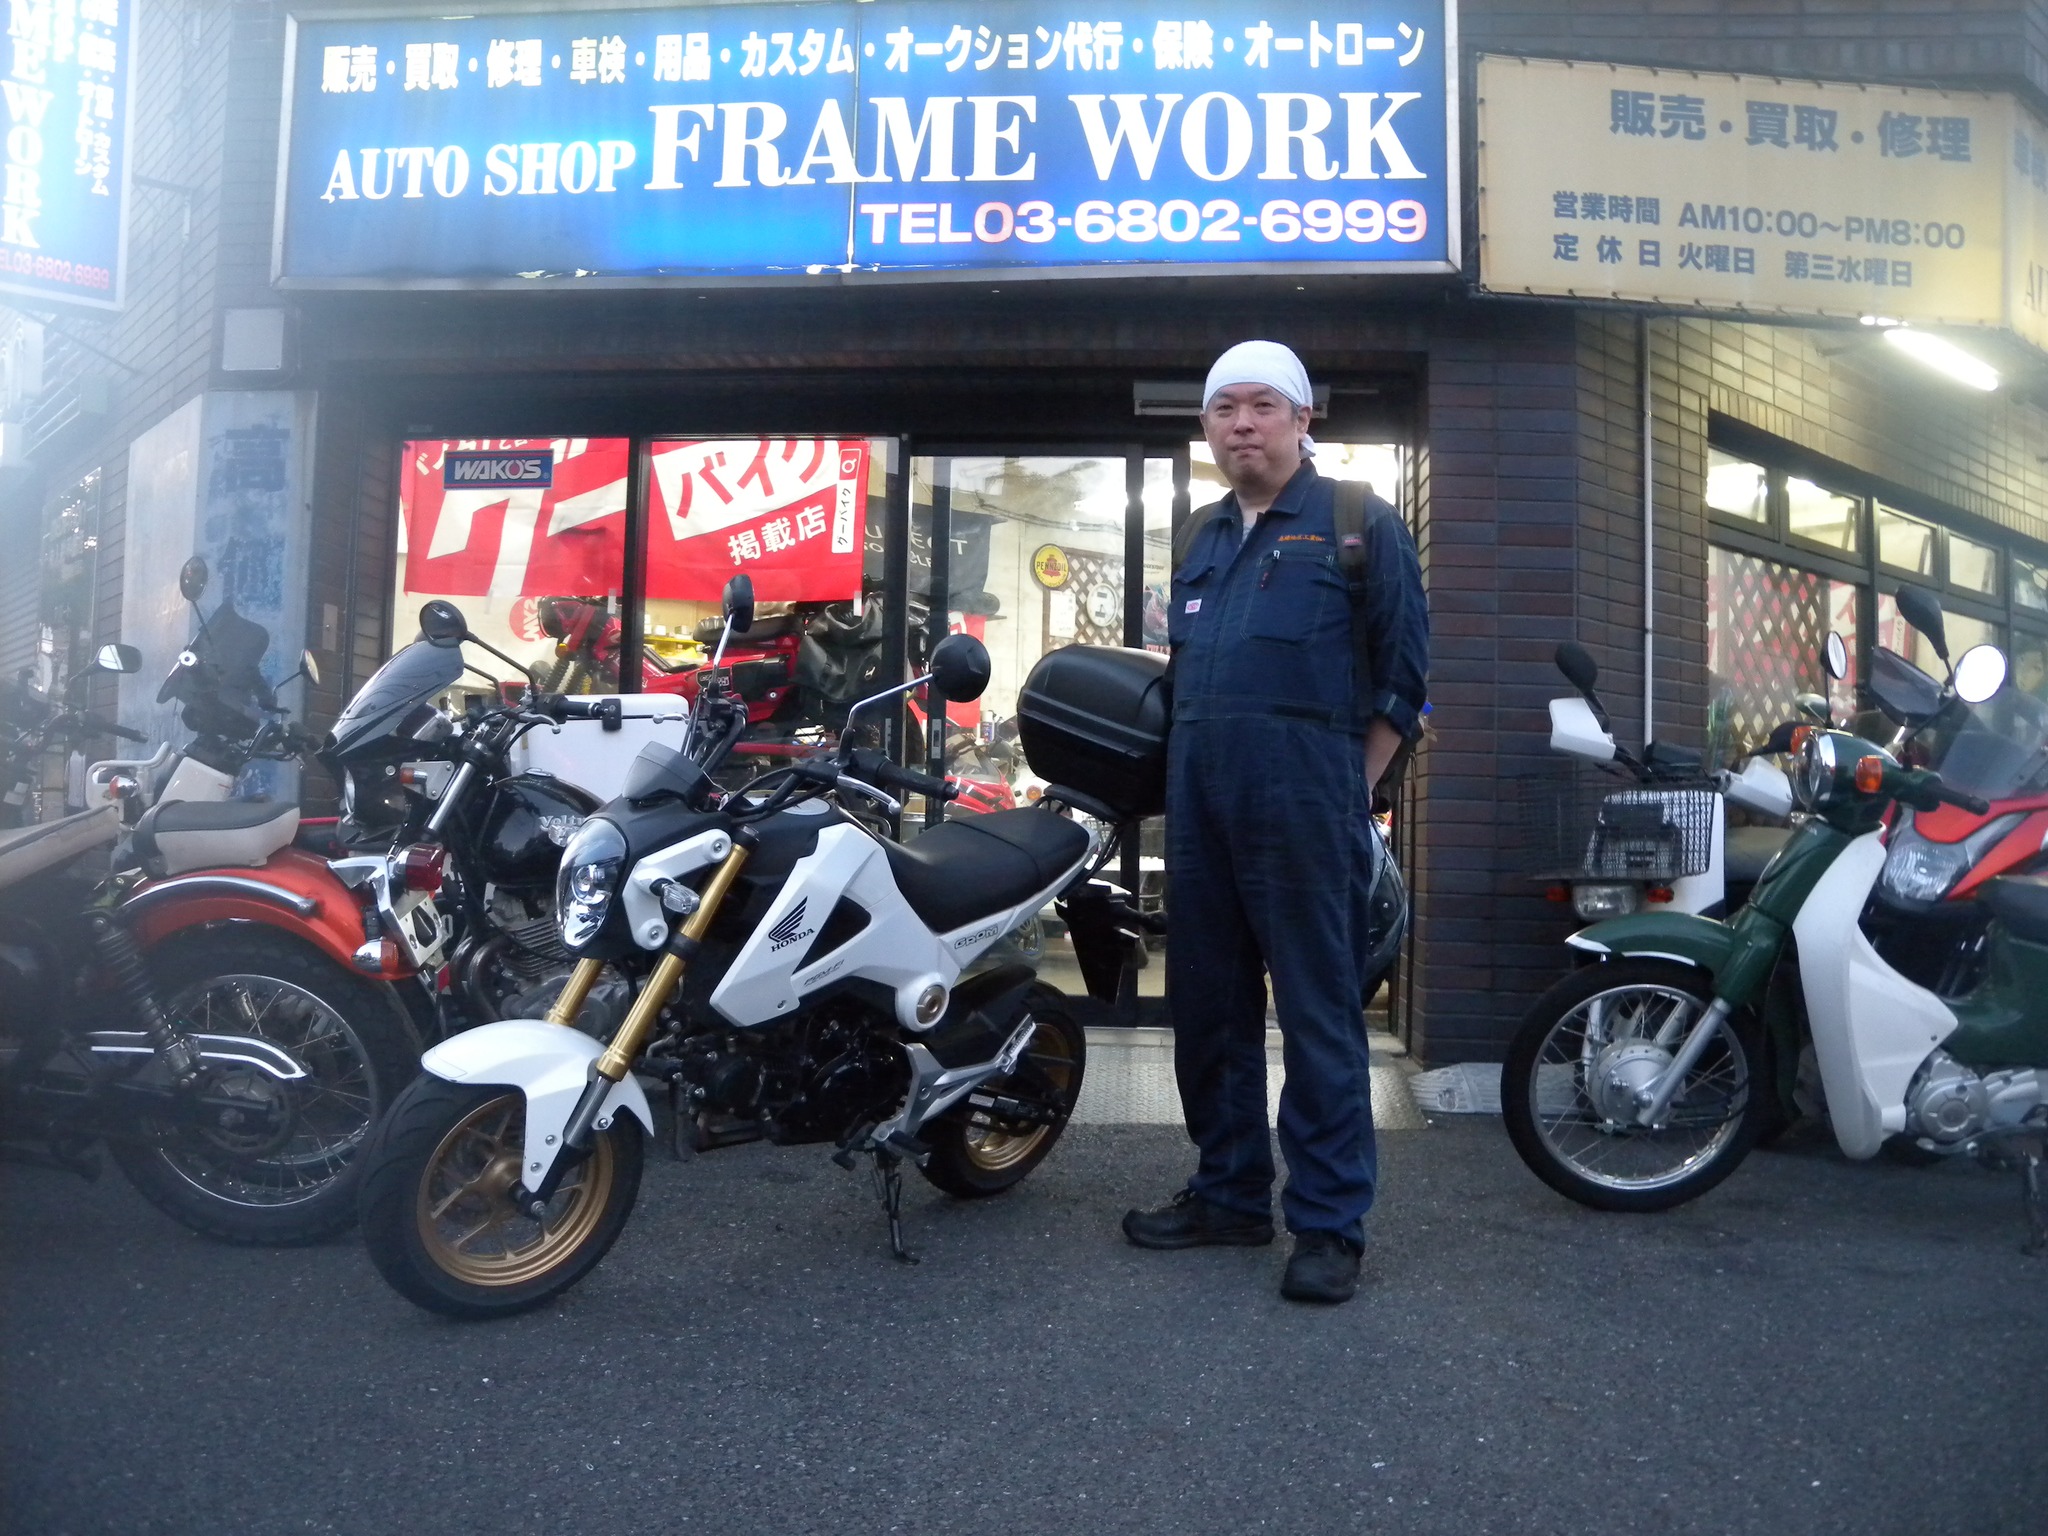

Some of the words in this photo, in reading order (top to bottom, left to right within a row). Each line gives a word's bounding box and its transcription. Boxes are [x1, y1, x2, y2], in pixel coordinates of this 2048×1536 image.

[320, 145, 470, 203] AUTO
[484, 141, 636, 196] SHOP
[644, 96, 1037, 190] FRAME
[1068, 91, 1427, 182] WORK
[1552, 190, 1660, 225] 営業時間
[1678, 241, 1756, 275] 火曜日
[1784, 250, 1913, 288] 第三水曜日
[727, 504, 827, 566] 掲載店
[771, 927, 815, 952] HONDA
[954, 925, 999, 949] GROM
